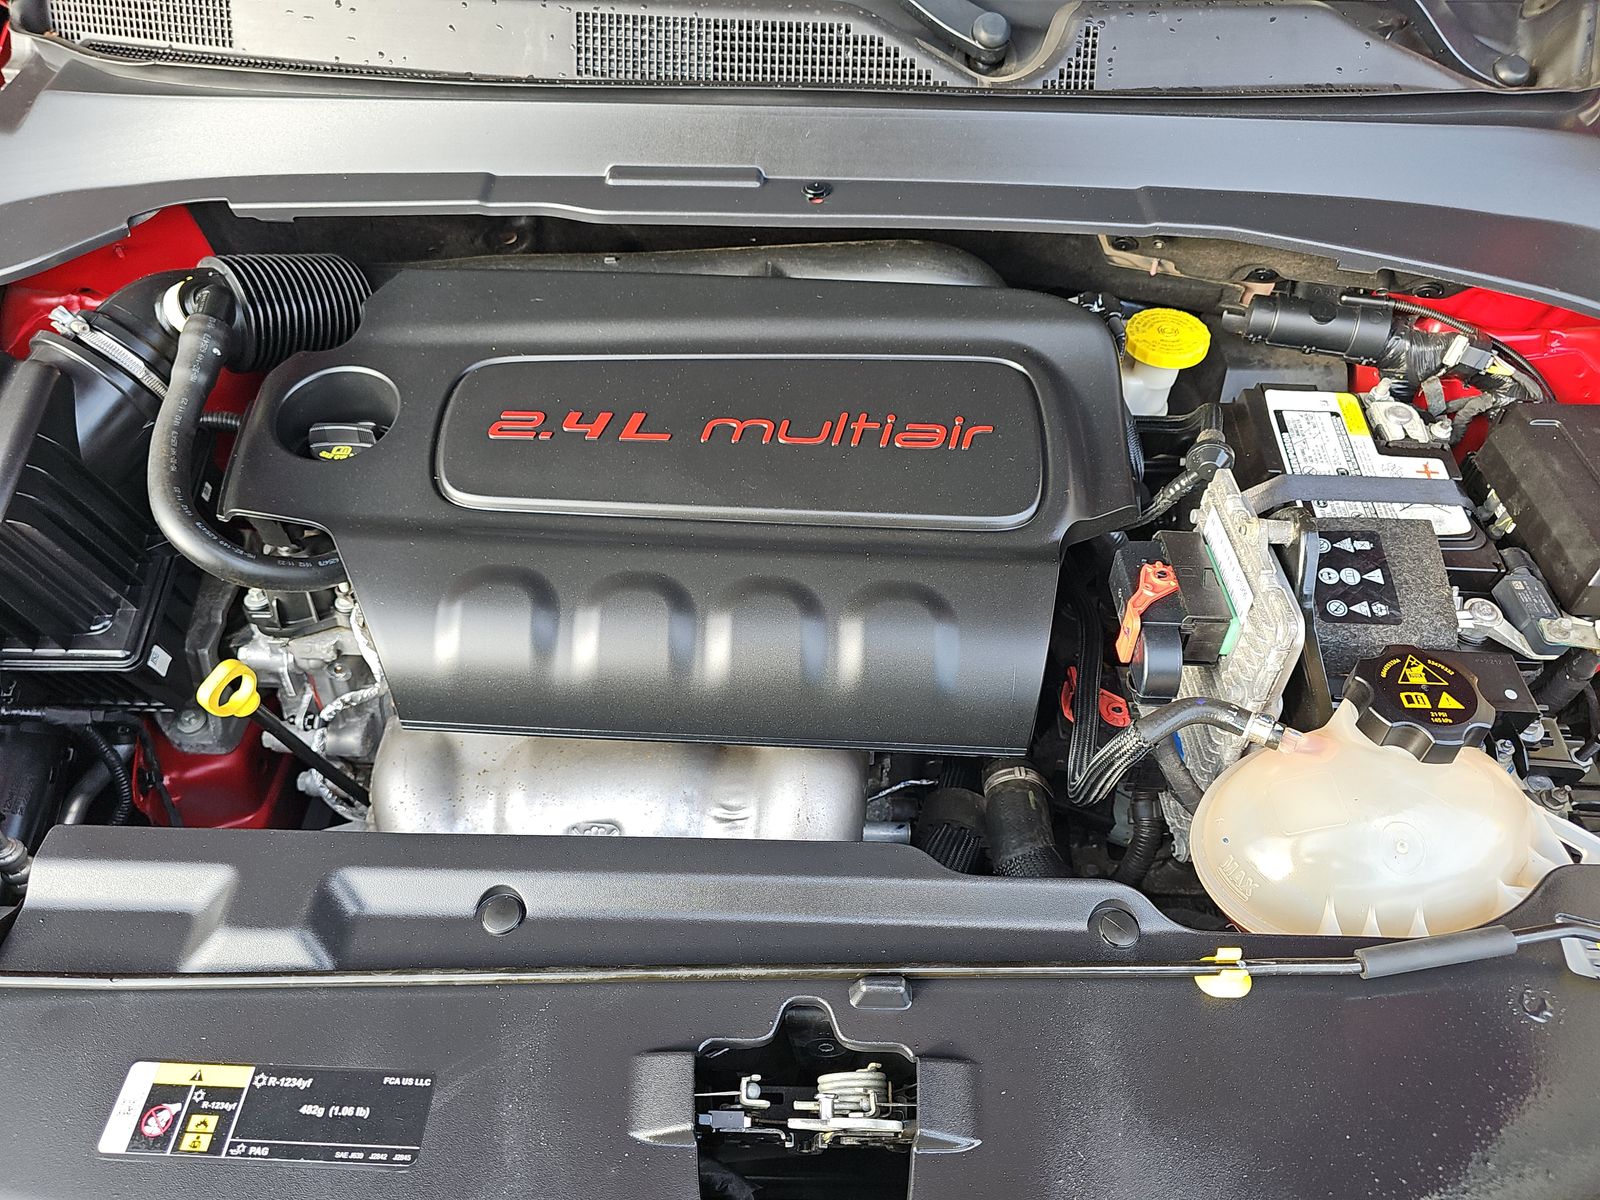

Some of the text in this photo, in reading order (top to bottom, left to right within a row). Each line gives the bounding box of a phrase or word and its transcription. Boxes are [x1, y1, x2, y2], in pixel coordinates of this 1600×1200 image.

[699, 411, 994, 451] multiair
[1219, 854, 1260, 897] MAX
[267, 1076, 313, 1090] R-1234yf
[383, 1077, 432, 1086] FCA US LLC
[202, 1101, 238, 1111] R-1234yf
[298, 1104, 370, 1119] 482g (1.06 lb)
[248, 1147, 270, 1156] PAG
